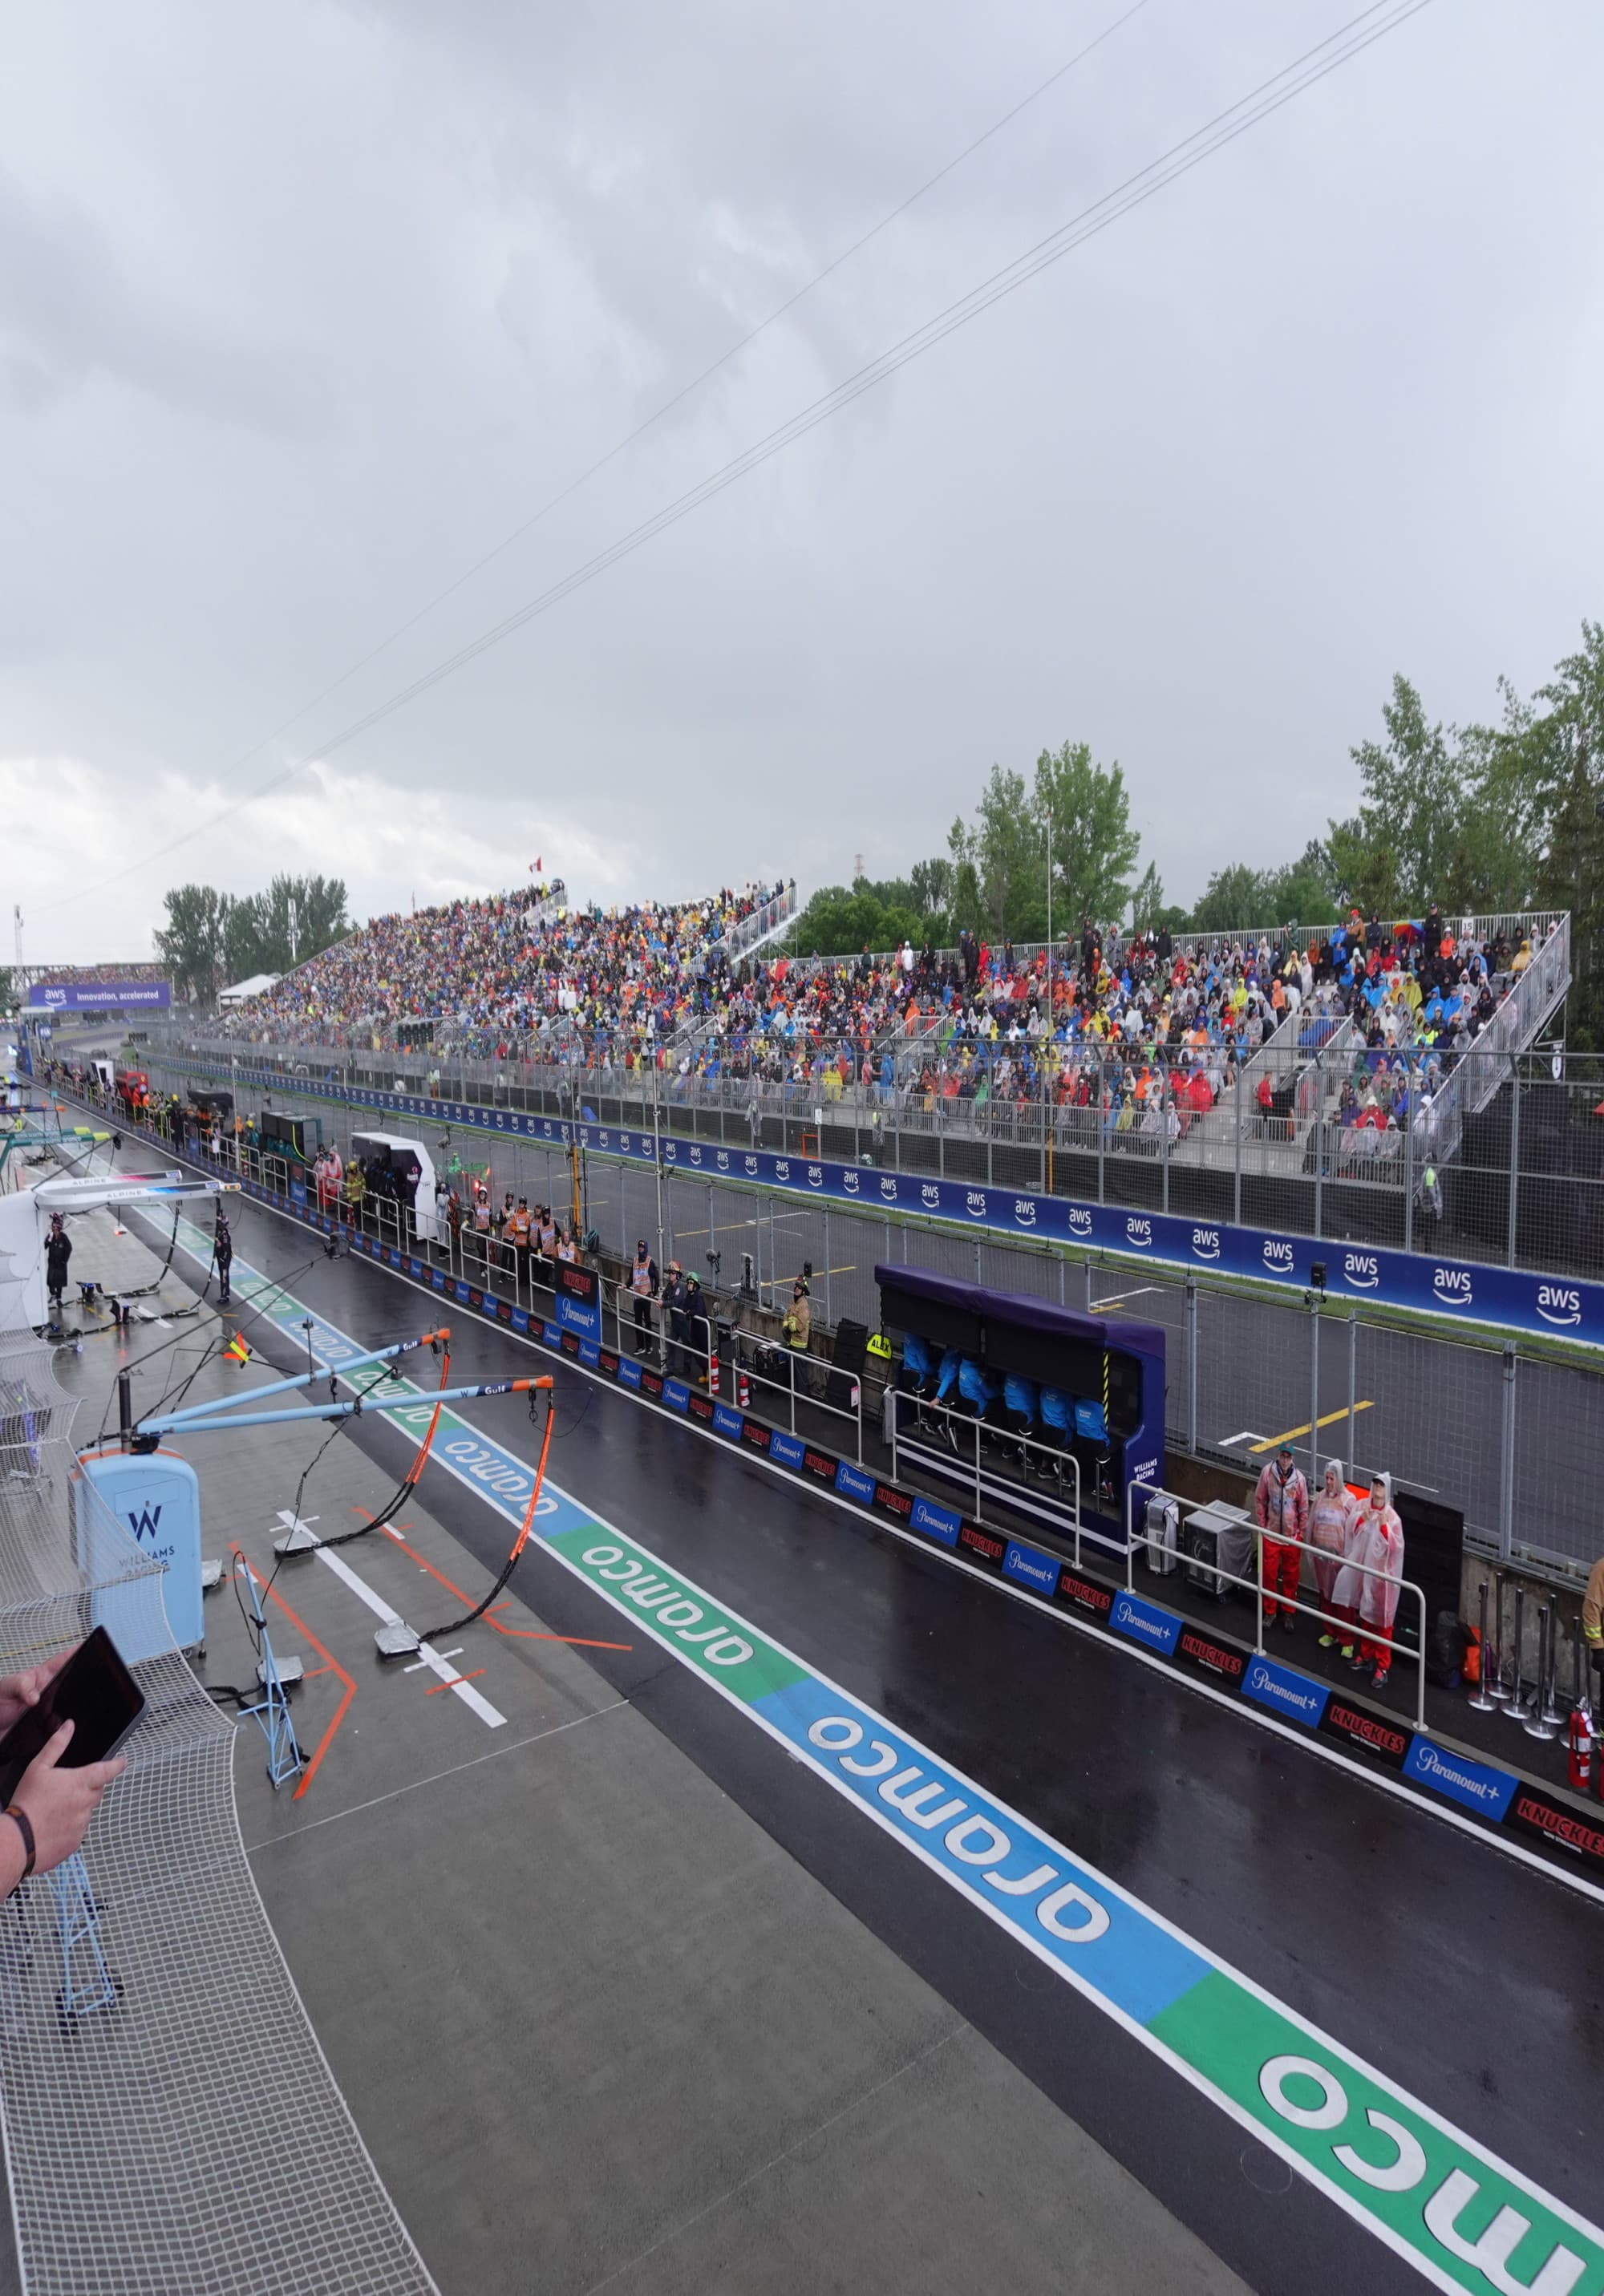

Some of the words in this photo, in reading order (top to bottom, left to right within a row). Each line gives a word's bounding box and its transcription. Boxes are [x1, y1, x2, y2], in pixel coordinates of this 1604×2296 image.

[45, 989, 66, 1000] aws
[77, 992, 118, 1002] Innovation,
[119, 990, 159, 1001] accelerated
[691, 1147, 701, 1157] aws
[717, 1151, 728, 1162] aws
[745, 1156, 757, 1168] aws
[776, 1160, 789, 1172] aws
[808, 1166, 822, 1178] aws
[844, 1172, 858, 1184] aws
[72, 1178, 107, 1186] ALPINE
[881, 1177, 897, 1191] aws
[921, 1184, 938, 1198] aws
[107, 1191, 142, 1199] ALPINE
[967, 1192, 985, 1206] aws
[1015, 1200, 1035, 1216] aws
[1069, 1209, 1091, 1225] aws
[1127, 1217, 1151, 1235] aws
[1193, 1229, 1219, 1247] aws
[1263, 1241, 1293, 1261] aws
[1345, 1253, 1378, 1275] aws
[1434, 1269, 1471, 1291] aws
[1538, 1286, 1580, 1310] aws
[403, 1340, 418, 1351] Gulf
[870, 1338, 890, 1354] ALX
[354, 1371, 434, 1423] armco
[460, 1390, 468, 1398] W
[484, 1385, 505, 1395] Gulf
[1133, 1458, 1157, 1474] WILLIAMS
[1136, 1468, 1155, 1481] RACING
[444, 1441, 559, 1516] aramco
[128, 1505, 162, 1542] W
[917, 1505, 954, 1533] Paramount+
[962, 1529, 1003, 1557] KNUCKLES
[1009, 1549, 1053, 1582] Paramount+
[1061, 1577, 1110, 1610] KNUCKLES
[581, 1545, 755, 1665] aramco
[1117, 1602, 1171, 1639] Paramount+
[1181, 1634, 1242, 1675] KNUCKLES
[1251, 1667, 1318, 1710] Paramount+
[1330, 1705, 1406, 1755] KNUCKLES
[1416, 1746, 1500, 1800] Paramount+
[807, 1715, 1112, 1943] aramco
[1517, 1797, 1604, 1858] KNUCKLE
[1258, 2054, 1604, 2296] mco
